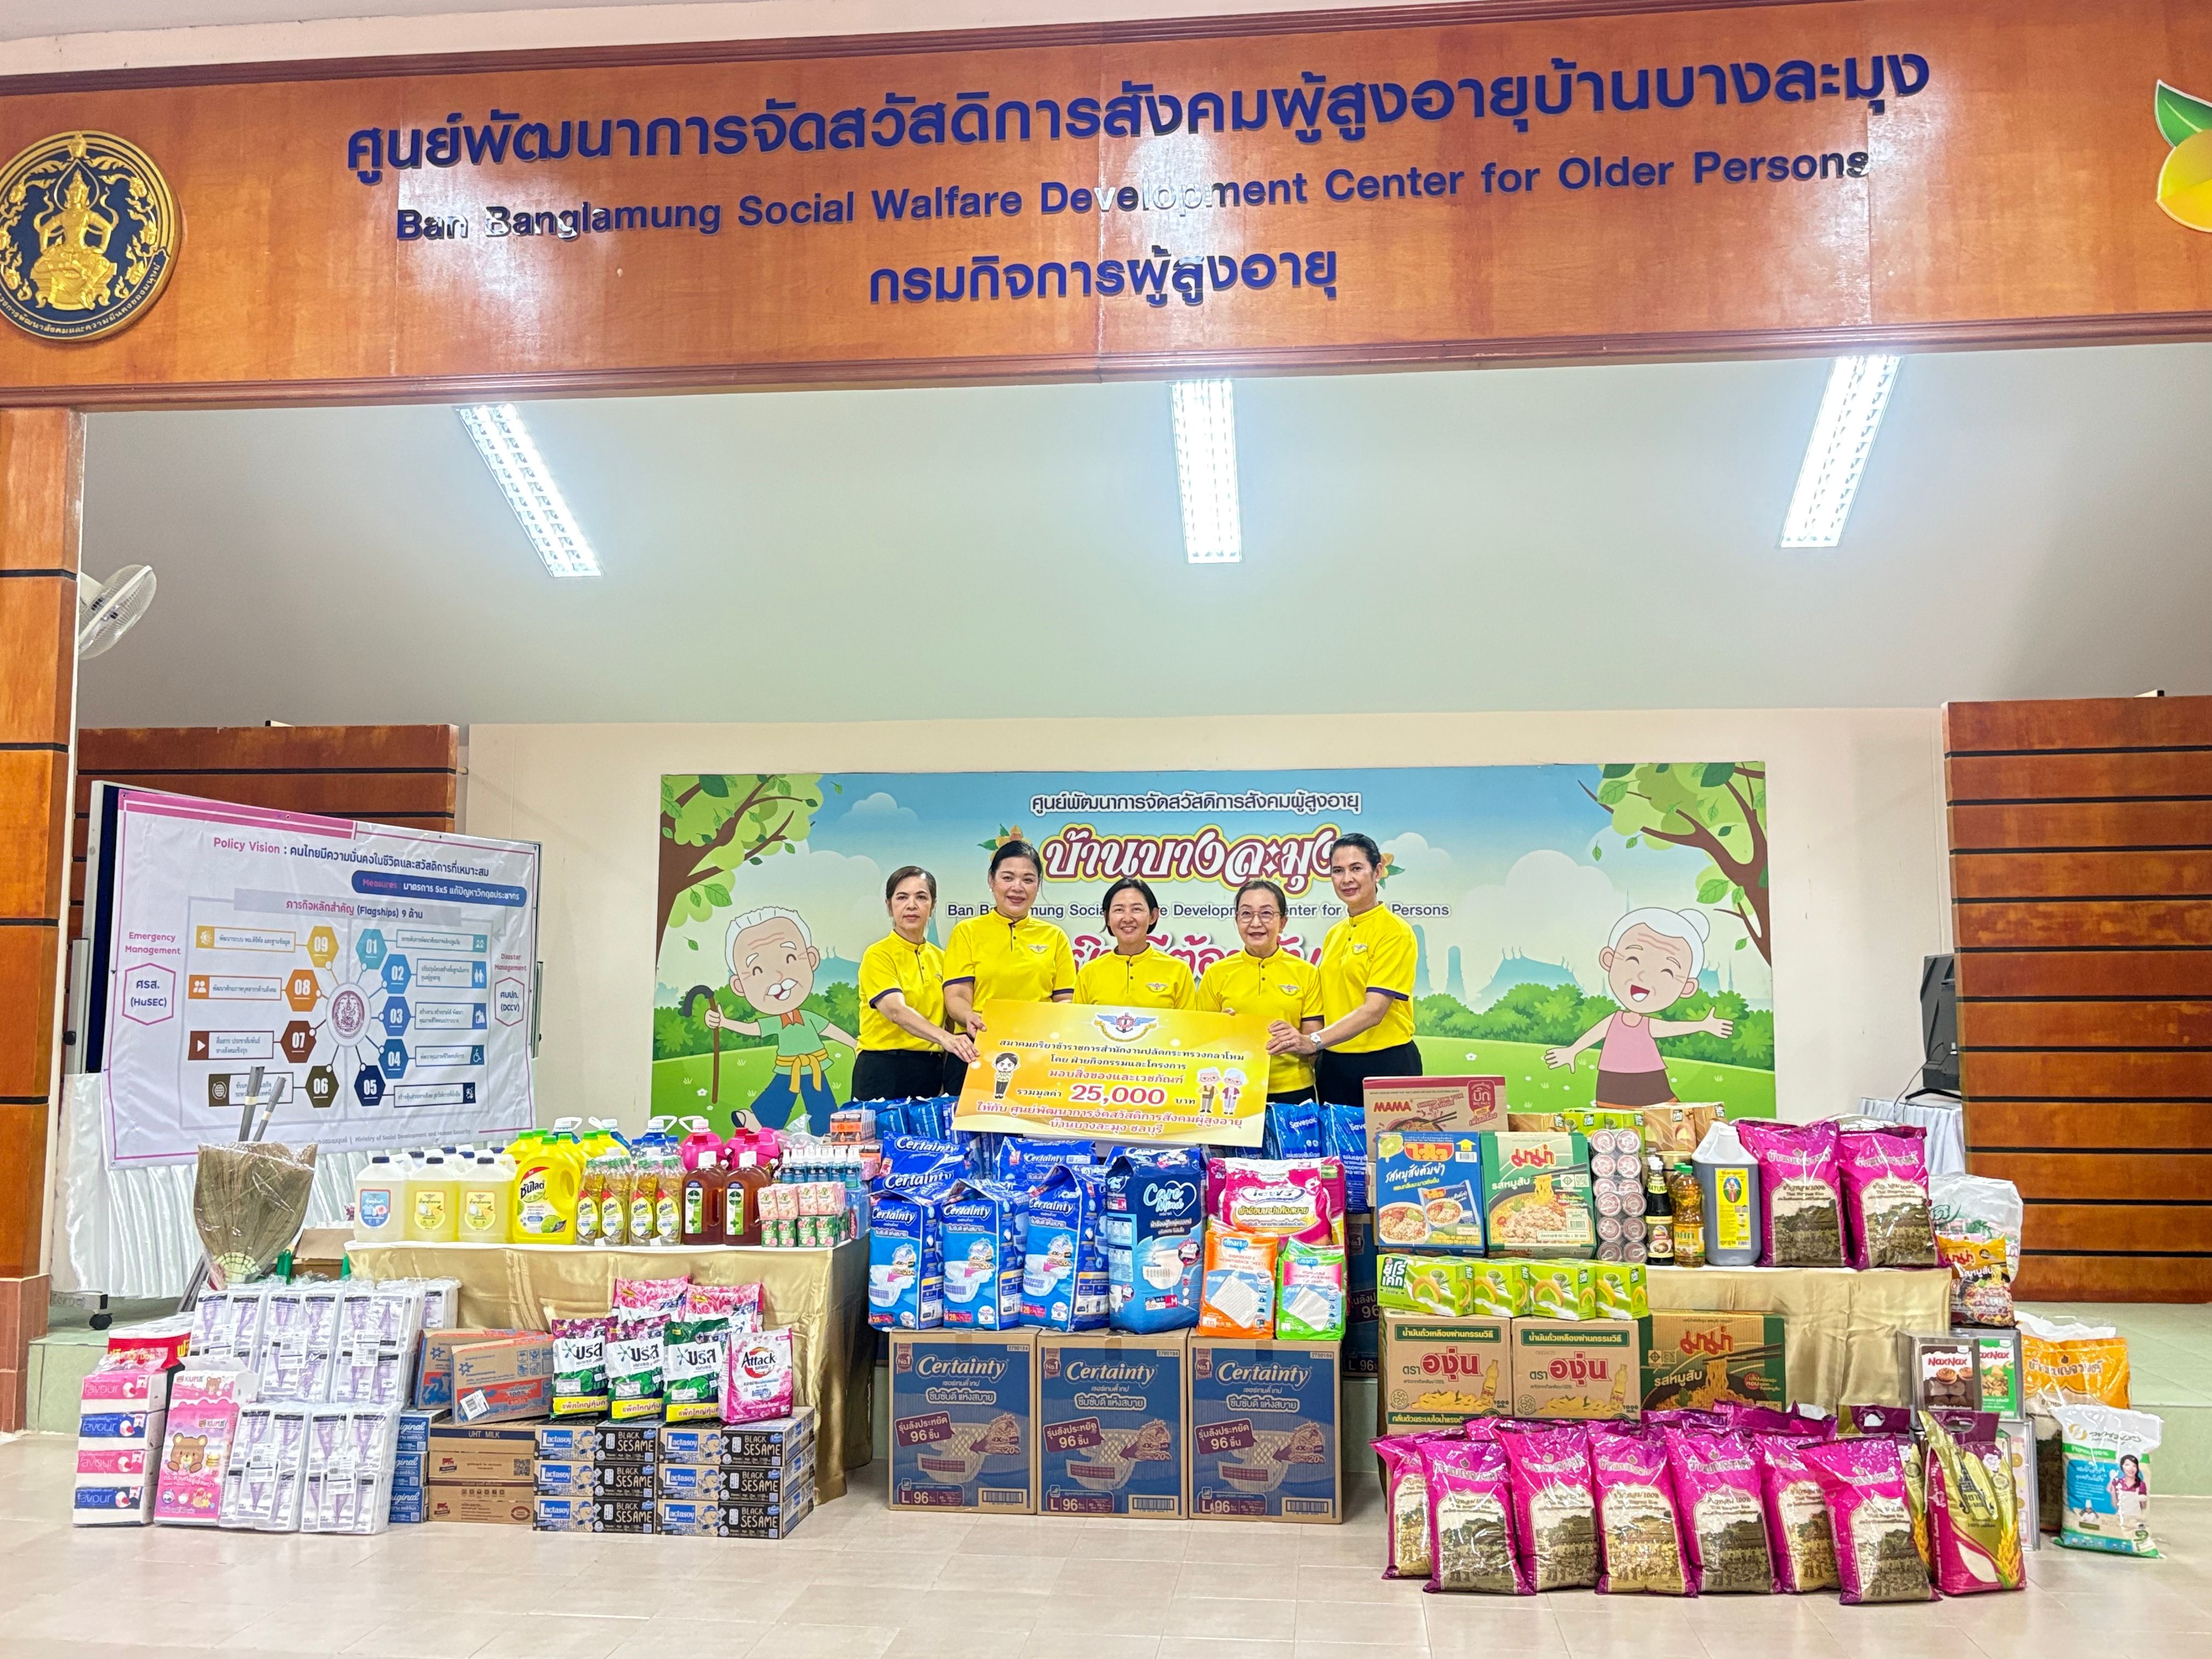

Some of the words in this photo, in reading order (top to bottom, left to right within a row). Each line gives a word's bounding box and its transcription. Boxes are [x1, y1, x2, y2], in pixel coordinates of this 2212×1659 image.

[347, 53, 1931, 184] ศูนย์พัฒนาการจัดสวัสดิการสังคมผู้สูงอายุบ้านบางละมุง
[397, 208, 468, 240] Ban
[485, 200, 721, 240] Banglamung
[738, 190, 856, 227] Social
[871, 186, 1023, 222] Walfare
[1041, 177, 1307, 217] Development
[1325, 166, 1466, 202] Center
[1480, 161, 1540, 195] for
[1559, 155, 1674, 190] Older
[1692, 148, 1871, 184] Persons
[869, 245, 1338, 306] กรมกิจการผู้สูงอายุ
[1032, 791, 1359, 815] ศูนย์พัฒนาการจัดสวัสดิการสังคมผู้สูงอายุ
[213, 837, 246, 852] Policy
[249, 840, 280, 854] Vision
[362, 878, 398, 889] Measures
[403, 883, 433, 893] มาตรการ
[357, 907, 399, 920] (Flagships)
[402, 909, 407, 918] 9
[409, 908, 423, 919] ด้าน
[947, 905, 974, 916] Ban
[1070, 904, 1105, 916] Socia
[1322, 904, 1340, 916] for
[1392, 905, 1449, 917] Persons
[128, 932, 176, 943] Emergency
[314, 936, 328, 952] 09
[125, 945, 181, 956] Management
[365, 939, 378, 955] 01
[500, 952, 522, 961] Disaster
[391, 965, 404, 981] 02
[494, 963, 528, 973] Management
[294, 979, 311, 996] 08
[130, 997, 167, 1008] (HuSEC)
[500, 1002, 520, 1013] (DCCV)
[390, 1008, 403, 1024] 03
[292, 1032, 306, 1049] 07
[999, 1038, 1244, 1061] สมาคมภริยาข้าราชการสำนักงานปลัดกระทรวงกลาโหม
[388, 1051, 401, 1067] 04
[1051, 1053, 1069, 1065] โดย
[1071, 1055, 1187, 1070] ฝ่ายกิจกรรมและโครงการ
[313, 1077, 329, 1094] 06
[363, 1079, 377, 1096] 05
[1016, 1087, 1062, 1099] รวมมูลค่า
[1070, 1082, 1165, 1106] 25,000
[1175, 1097, 1196, 1106] บาท
[976, 1101, 1008, 1114] ให้กับ
[1373, 1101, 1412, 1113] MAMA
[1049, 1116, 1127, 1135] บ้านบางละมุง
[1511, 1143, 1555, 1167] มาม่า
[1492, 1177, 1530, 1190] รสหมูสับ
[1143, 1183, 1184, 1206] Care
[943, 1204, 991, 1221] Certainty
[1029, 1199, 1074, 1215] Certainty
[872, 1208, 916, 1224] Certainty
[1679, 1325, 1734, 1355] มาม่า
[741, 1351, 776, 1368] Attack
[1928, 1357, 1968, 1366] NaxNax
[1979, 1351, 2010, 1360] axNax
[918, 1356, 1006, 1380] Certainty
[1359, 1359, 1374, 1372] 96
[1402, 1365, 1421, 1375] ตรา
[1421, 1347, 1482, 1381] องุ่น
[1529, 1370, 1548, 1380] ตรา
[1549, 1351, 1611, 1387] องุ่น
[1066, 1361, 1155, 1386] Certainty
[1218, 1362, 1309, 1387] Certainty
[1654, 1369, 1702, 1387] รสหมูสับ
[84, 1383, 120, 1395] favour
[958, 1390, 994, 1402] แห้งสบาย
[1107, 1396, 1143, 1408] แห้งสบาย
[1260, 1398, 1297, 1409] แห้งสบาย
[81, 1419, 116, 1433] favour
[898, 1416, 948, 1434] รุ่นลังประหยัด
[1047, 1421, 1097, 1440] รุ่นลังประหยัด
[1198, 1423, 1250, 1442] รุ่นลังประหยัด
[468, 1430, 482, 1438] UHT
[485, 1431, 500, 1439] MILK
[542, 1432, 572, 1447] Lactasoy
[618, 1431, 641, 1440] BLACK
[744, 1435, 767, 1443] BLACK
[910, 1429, 928, 1443] 96
[928, 1429, 940, 1440] ชิ้น
[1059, 1435, 1076, 1449] 96
[1077, 1435, 1090, 1446] ชิ้น
[617, 1440, 654, 1452] SESAME
[668, 1435, 698, 1451] Lactasoy
[743, 1443, 781, 1456] SESAME
[1210, 1436, 1229, 1450] 96
[1229, 1436, 1242, 1447] ชิ้น
[79, 1456, 114, 1469] favour
[541, 1467, 571, 1482] Lactasoy
[616, 1466, 639, 1476] BLACK
[665, 1470, 696, 1486] Lactasoy
[742, 1470, 764, 1480] BLACK
[616, 1475, 653, 1488] SESAME
[741, 1480, 778, 1493] SESAME
[77, 1493, 112, 1505] favour
[901, 1491, 910, 1504] L
[913, 1491, 929, 1504] 96
[1050, 1498, 1059, 1511] L
[1063, 1498, 1079, 1511] 96
[540, 1502, 571, 1518] Lactasoy
[616, 1502, 639, 1510] BLACK
[741, 1506, 764, 1515] BLACK
[1201, 1500, 1211, 1513] L
[1215, 1500, 1231, 1513] 96
[615, 1510, 653, 1523] SESAME
[664, 1506, 695, 1522] Lactasoy
[740, 1515, 778, 1528] SESAME
